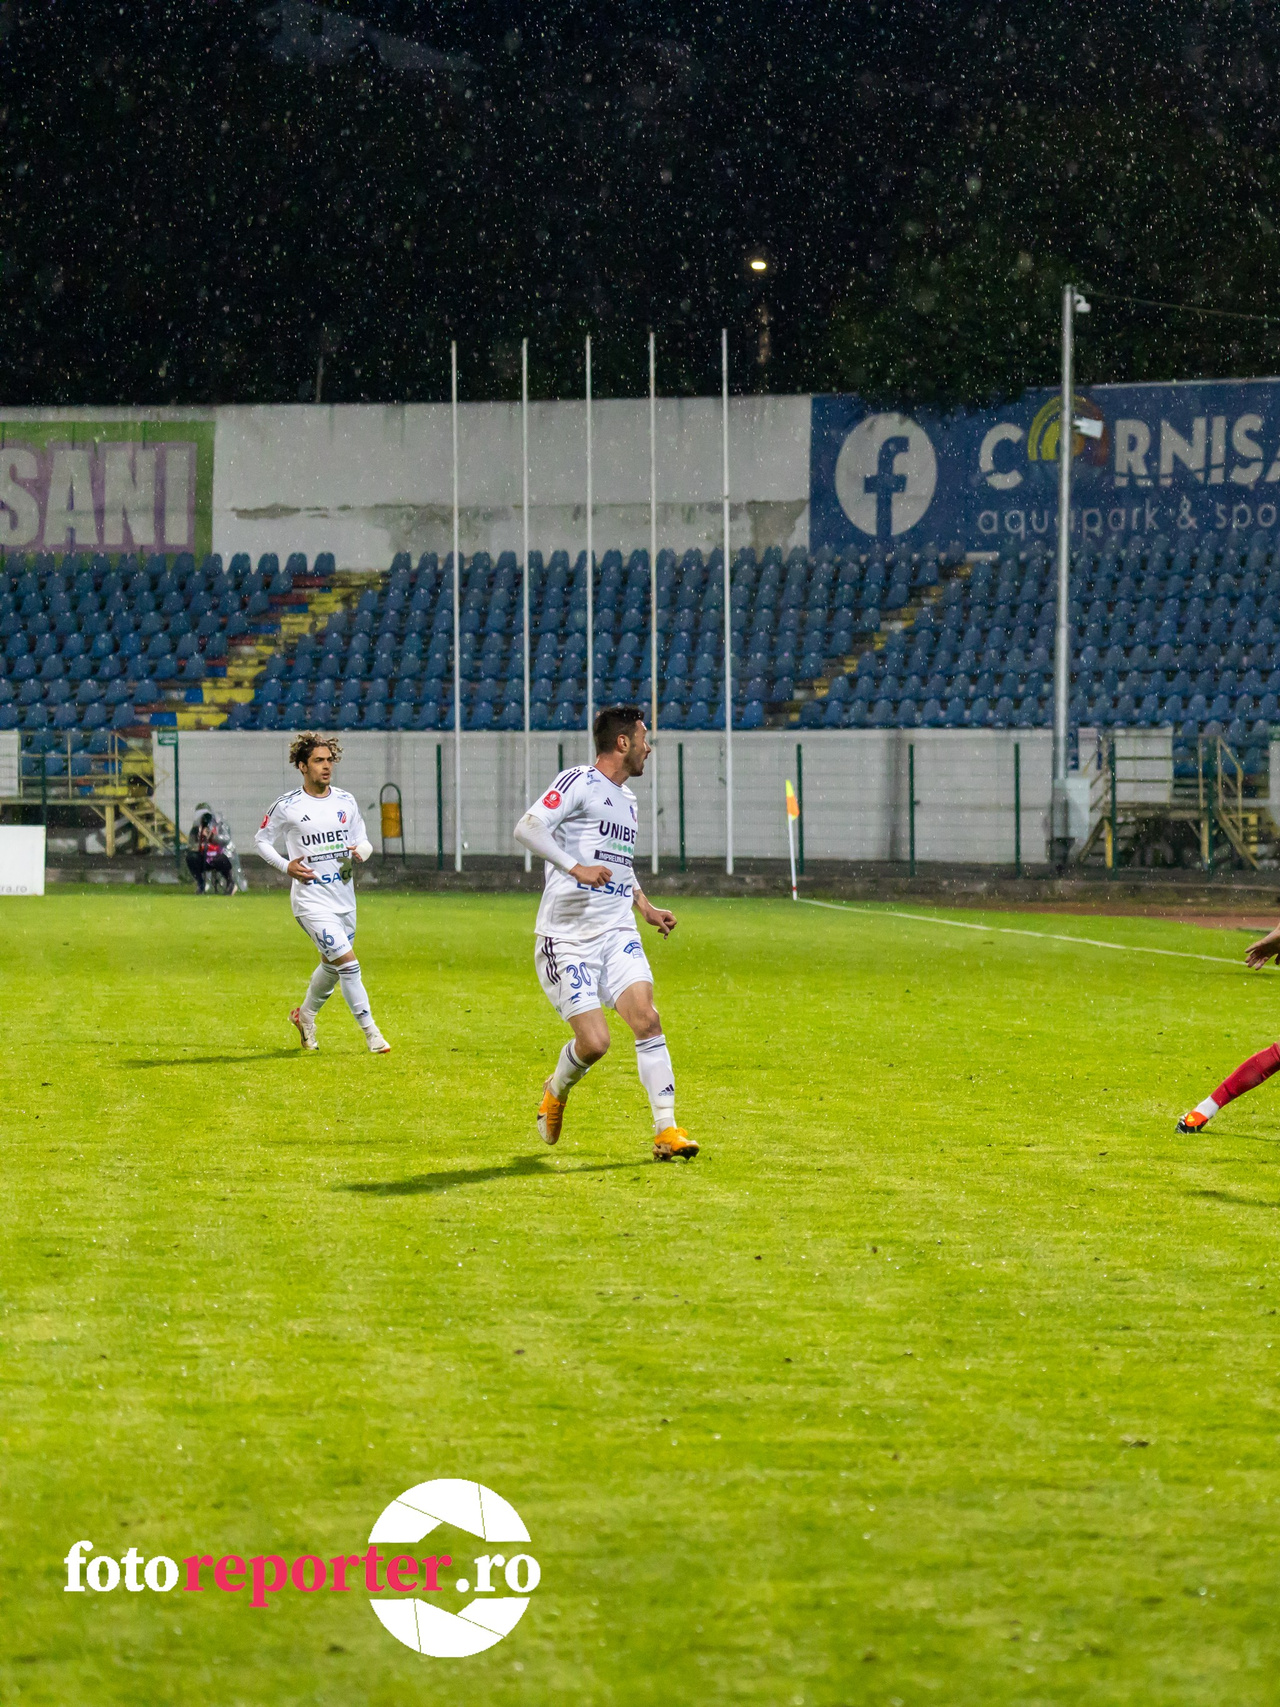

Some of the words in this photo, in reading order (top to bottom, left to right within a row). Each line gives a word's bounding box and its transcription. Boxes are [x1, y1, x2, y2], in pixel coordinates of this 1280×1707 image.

[0, 447, 189, 547] SANI
[1177, 500, 1197, 530] &
[301, 829, 350, 847] UNIBET
[565, 961, 592, 990] 30
